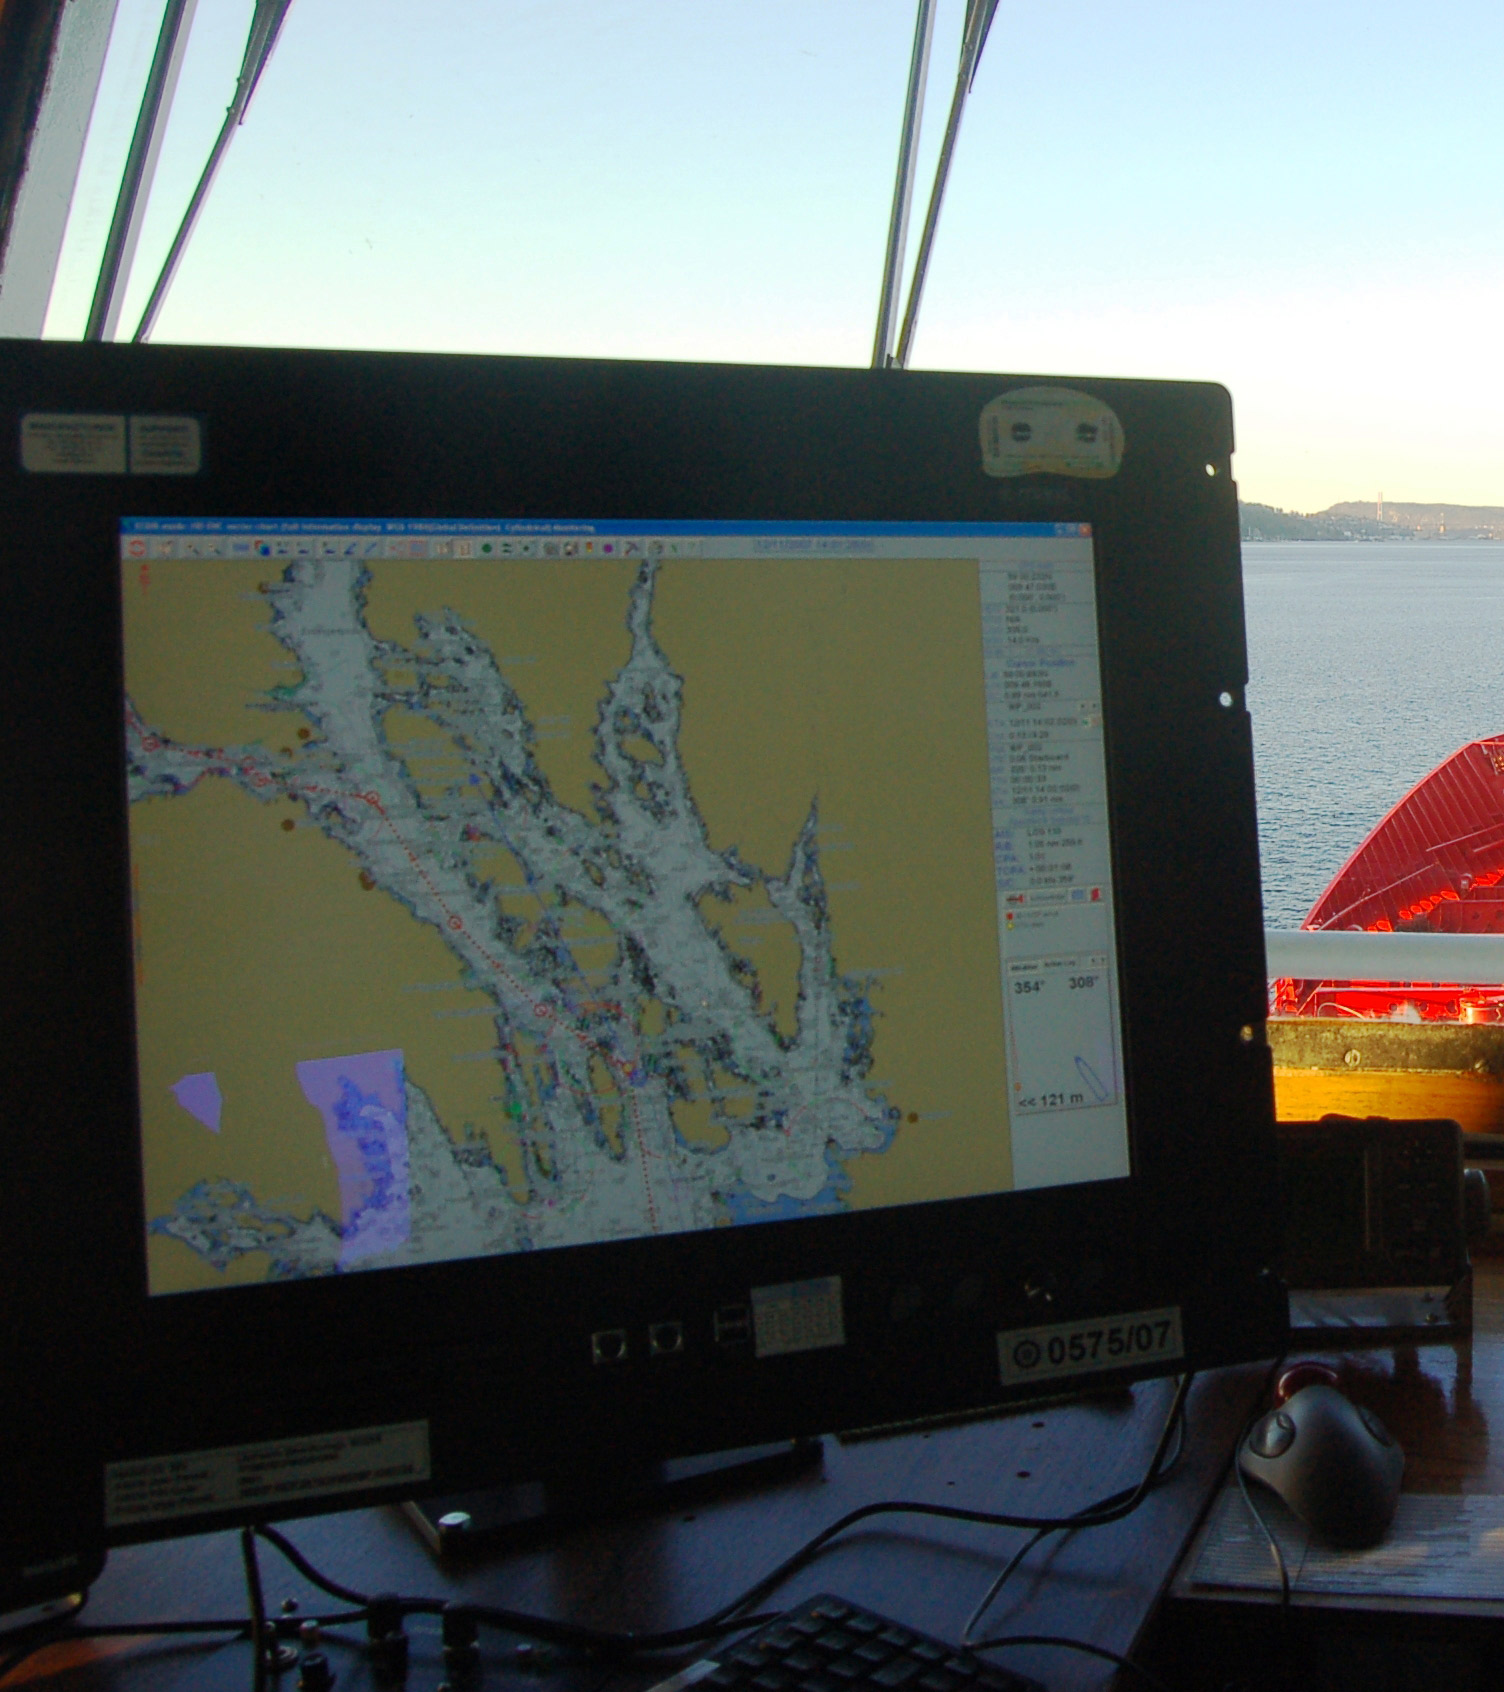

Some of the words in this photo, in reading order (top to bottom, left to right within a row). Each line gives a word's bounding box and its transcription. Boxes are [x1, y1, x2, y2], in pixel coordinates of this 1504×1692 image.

[1041, 1093, 1063, 1106] 121
[1070, 1093, 1083, 1103] m
[1047, 1319, 1172, 1365] 0575/07
